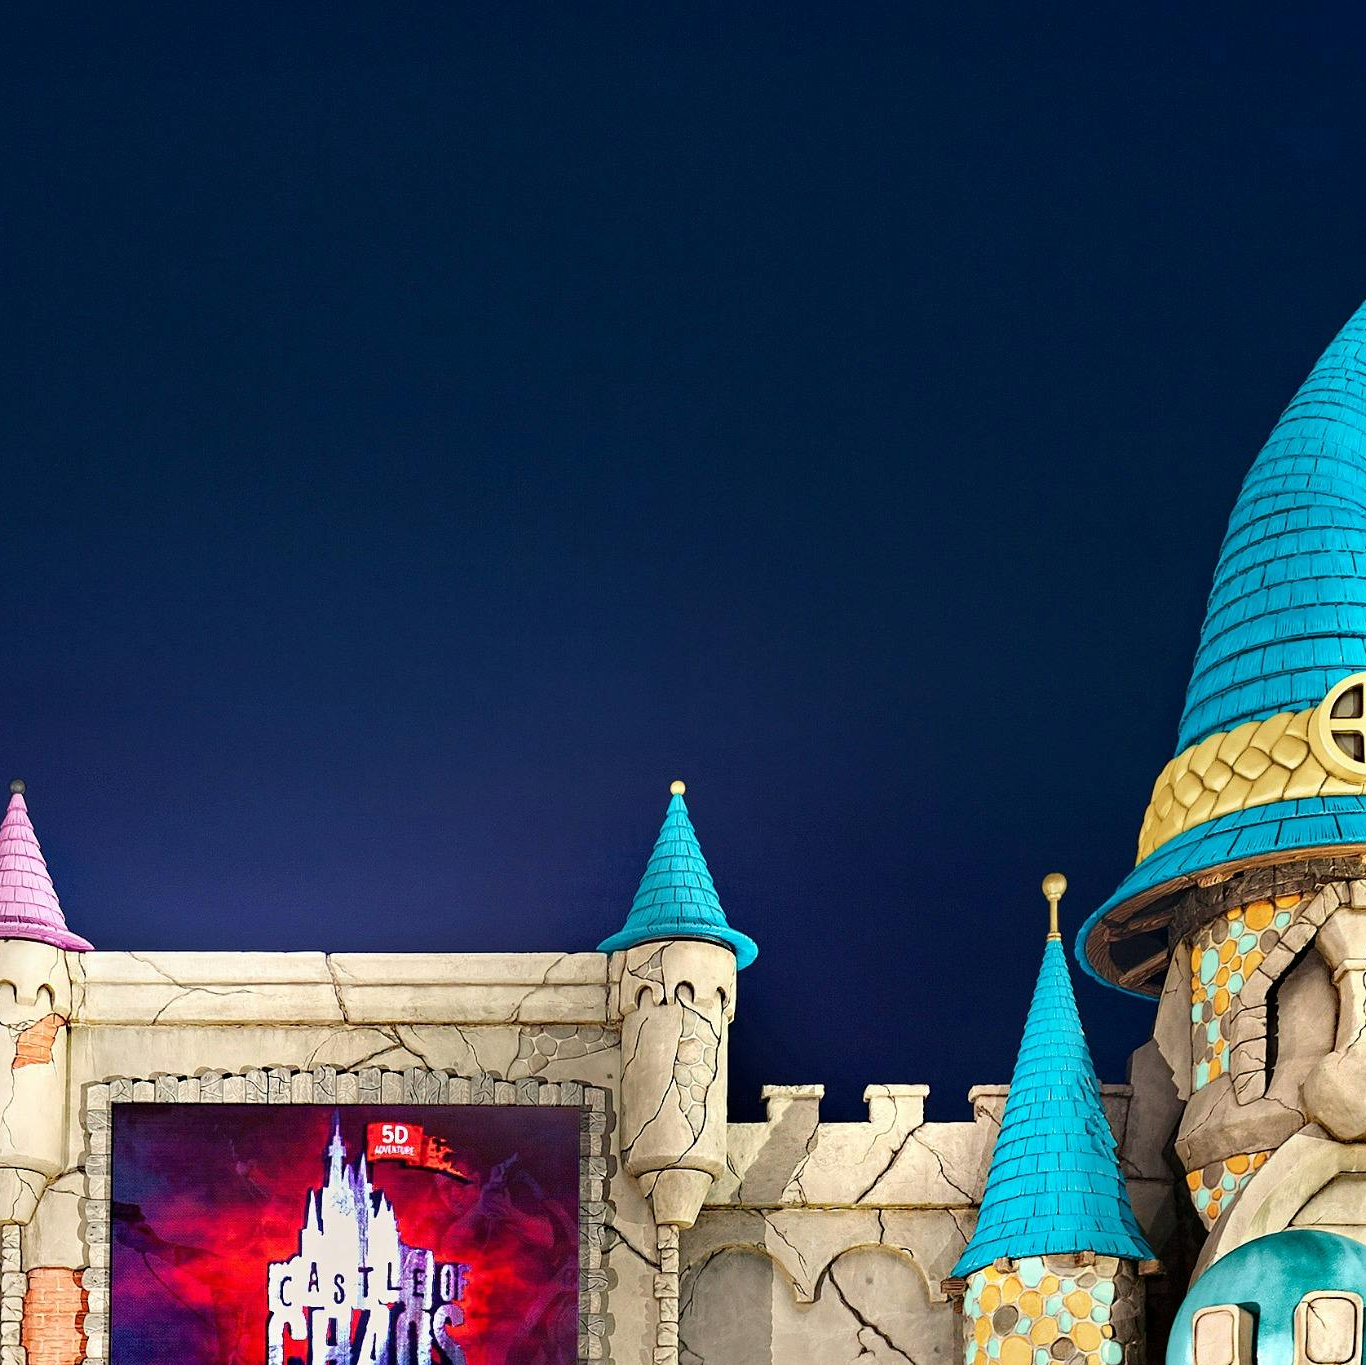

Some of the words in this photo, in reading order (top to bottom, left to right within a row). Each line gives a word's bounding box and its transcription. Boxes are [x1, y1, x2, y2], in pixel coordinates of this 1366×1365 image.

[382, 1124, 409, 1145] 5D
[374, 1145, 415, 1156] ADVENTURE
[279, 1261, 426, 1307] CASTLE
[439, 1263, 472, 1303] OF
